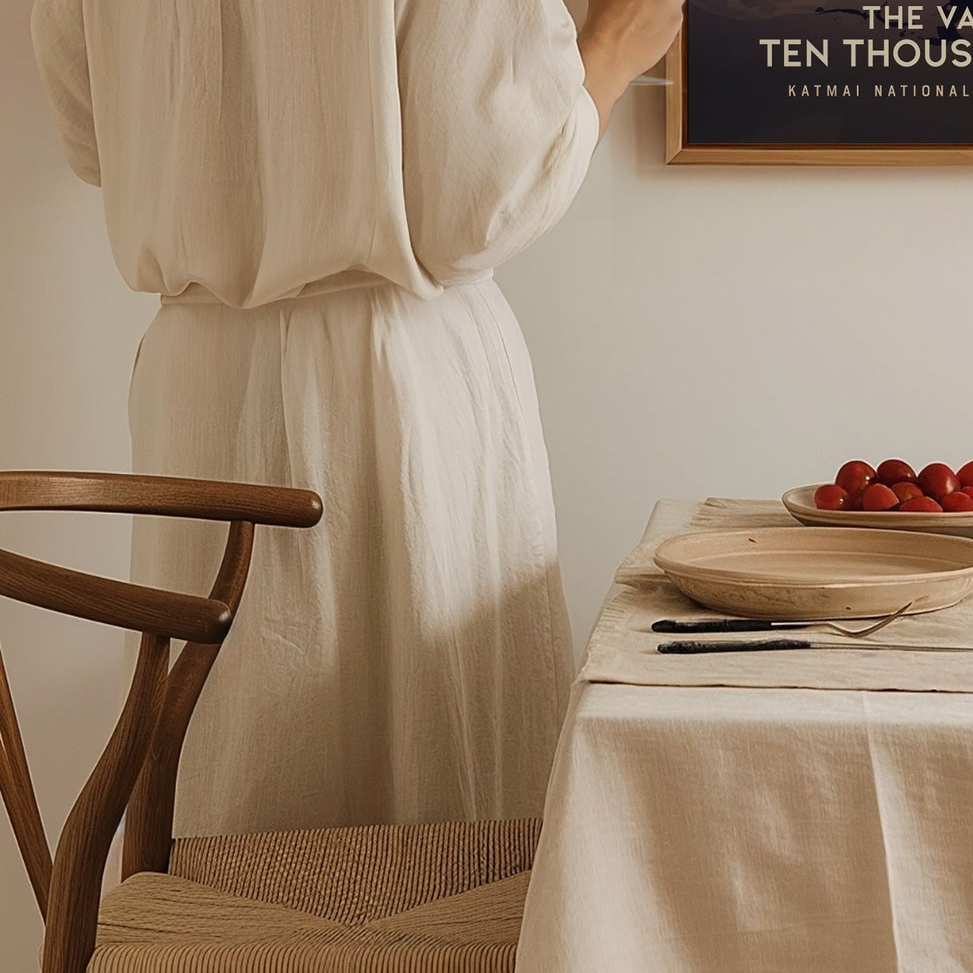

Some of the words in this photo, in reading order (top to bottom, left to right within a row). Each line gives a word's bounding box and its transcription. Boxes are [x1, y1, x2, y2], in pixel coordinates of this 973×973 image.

[862, 5, 924, 30] THE
[759, 39, 829, 67] TEN
[788, 84, 860, 97] KATMAI
[874, 84, 970, 97] NATIONAL
